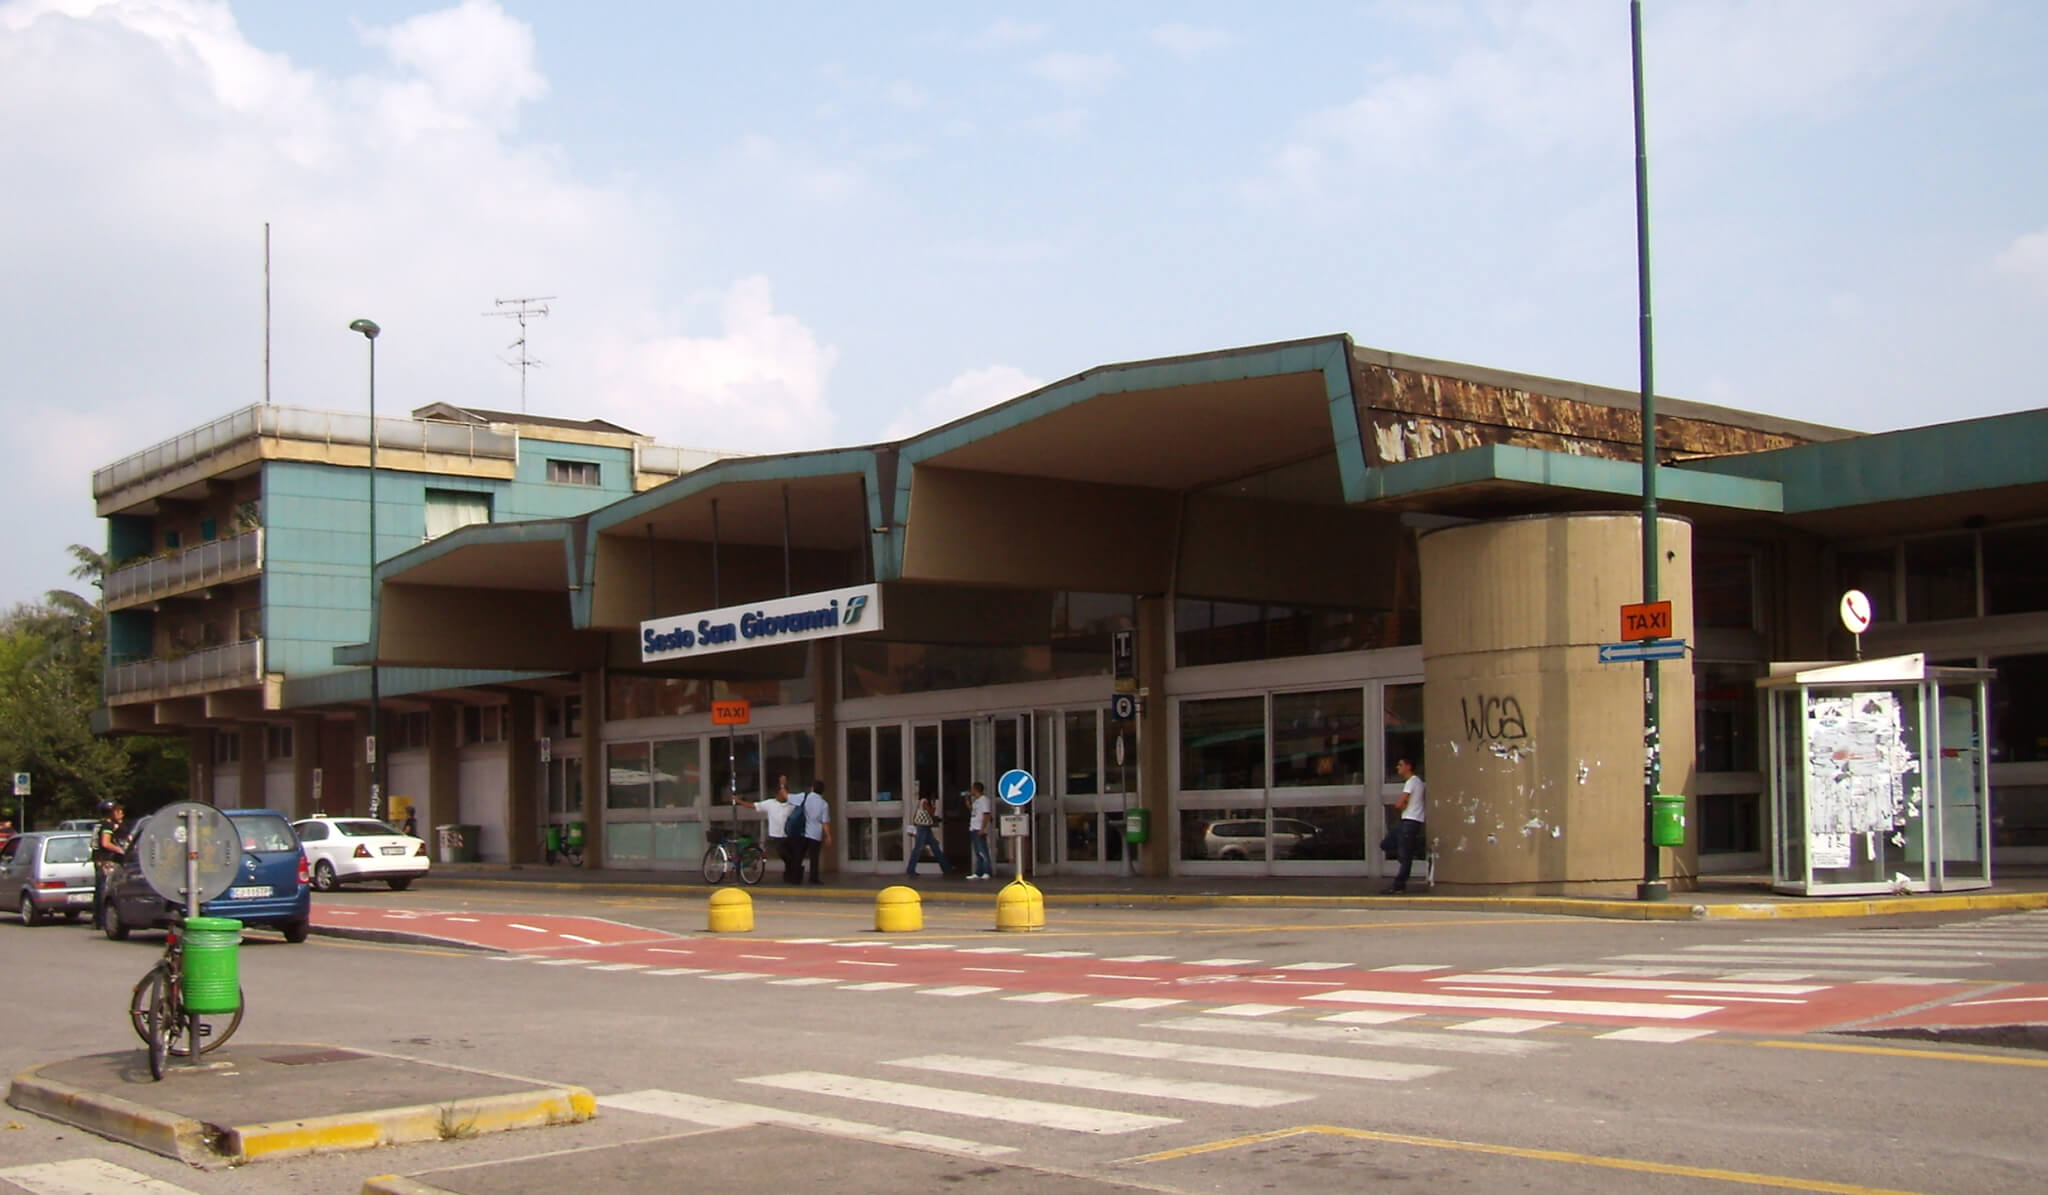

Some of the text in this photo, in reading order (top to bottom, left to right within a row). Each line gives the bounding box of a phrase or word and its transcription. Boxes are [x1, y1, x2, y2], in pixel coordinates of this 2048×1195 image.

[644, 600, 839, 654] Sesto San Giovanni
[1627, 612, 1666, 630] TAXI
[717, 707, 744, 718] TAXI
